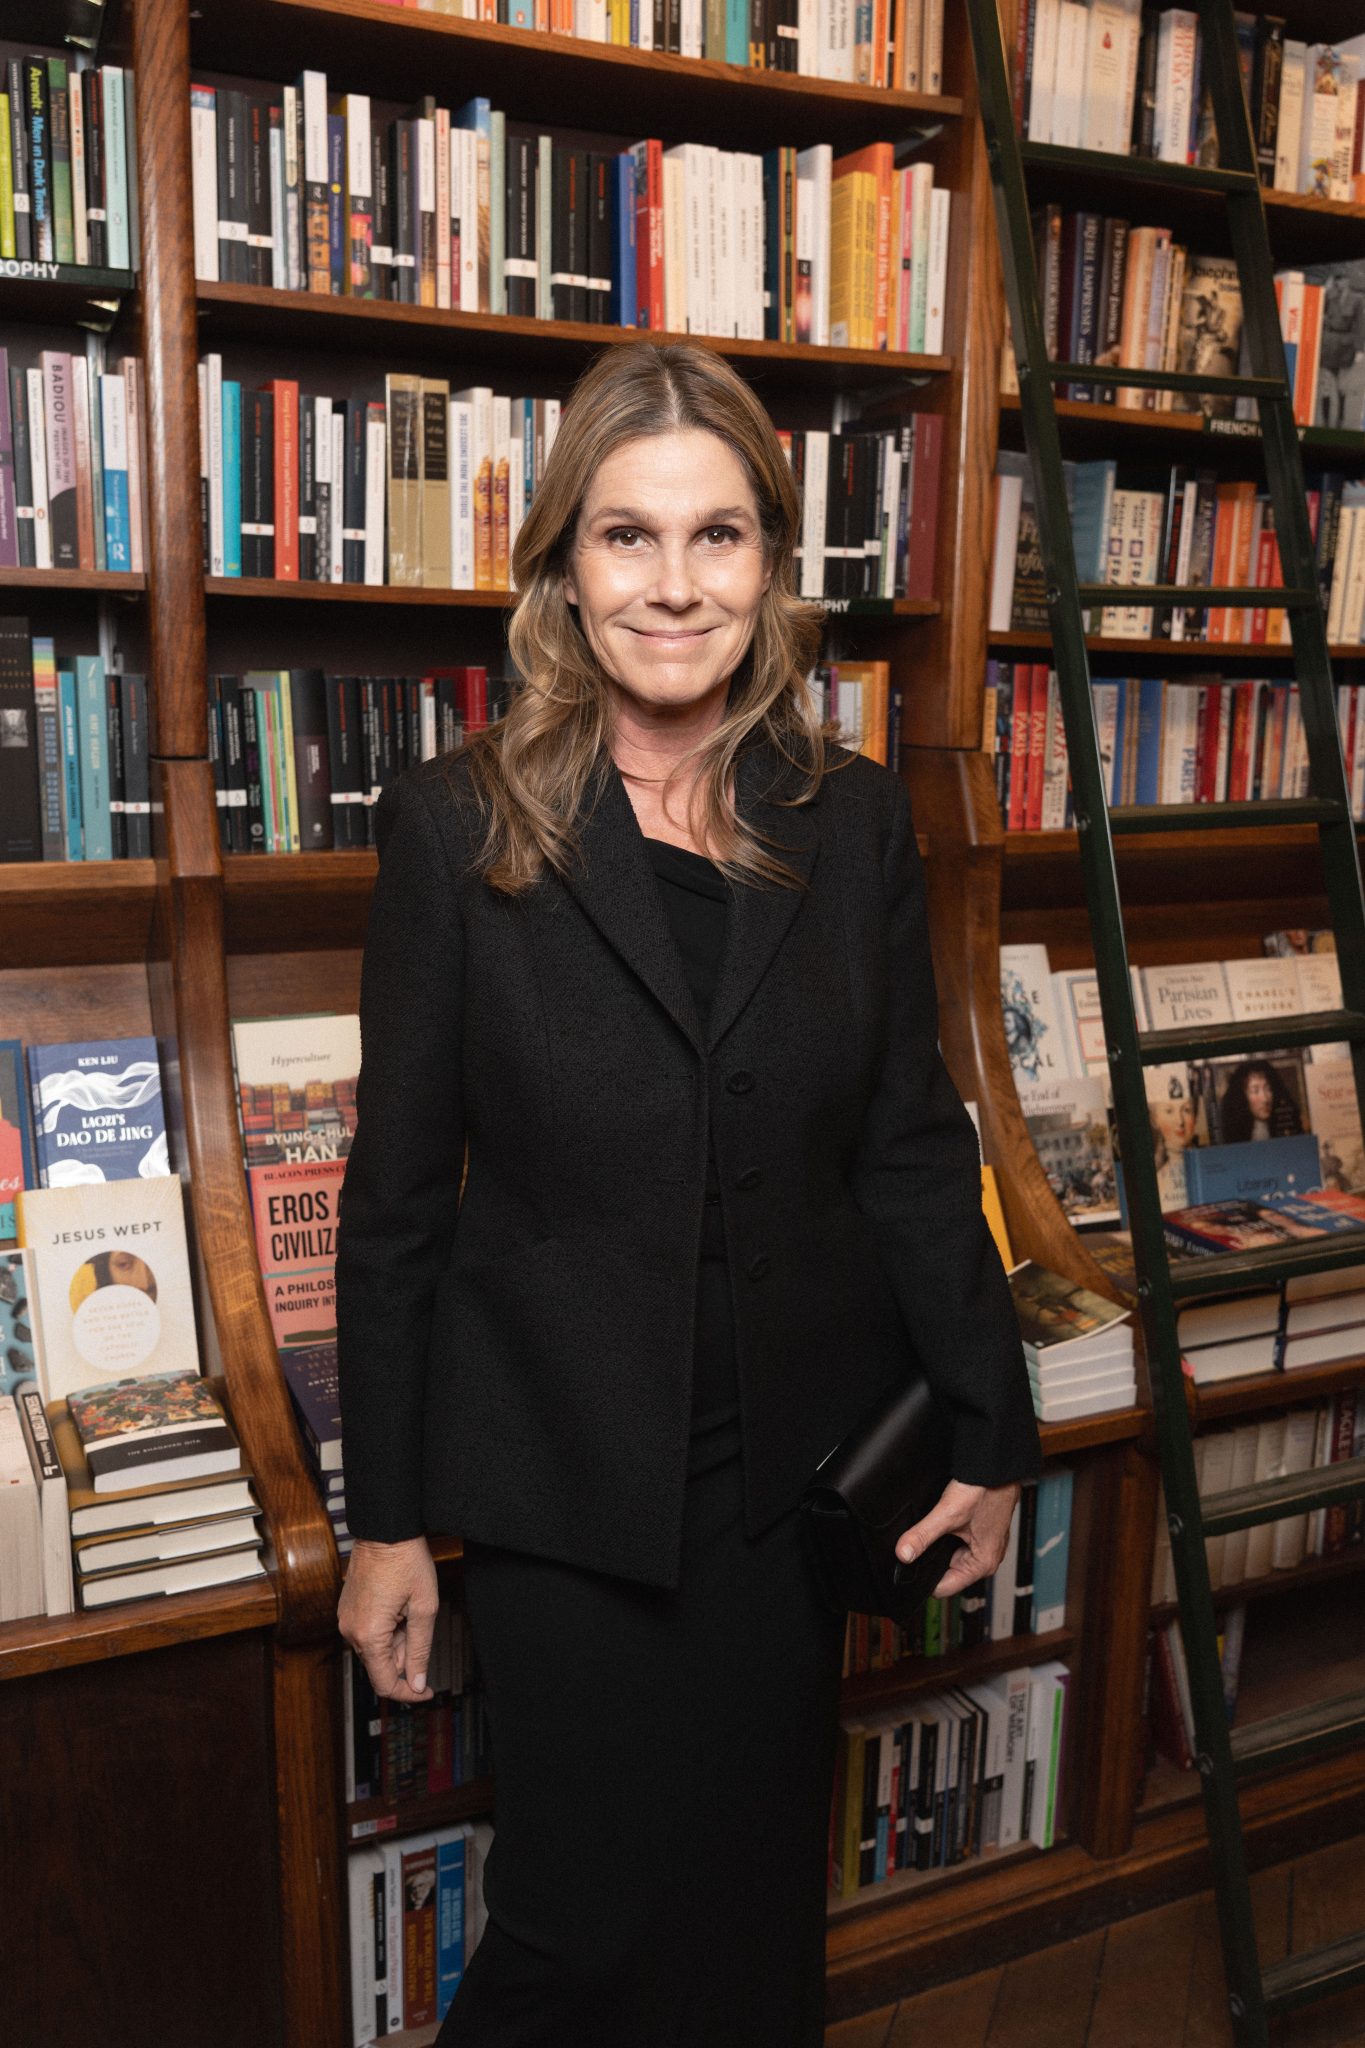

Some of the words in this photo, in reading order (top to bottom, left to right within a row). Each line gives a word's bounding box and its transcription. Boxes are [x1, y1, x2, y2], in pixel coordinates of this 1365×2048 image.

[30, 67, 42, 109] Arendt
[1171, 86, 1186, 148] Citizens
[32, 117, 44, 141] Men
[33, 145, 44, 156] in
[33, 159, 45, 185] Dark
[35, 188, 46, 220] Times
[879, 243, 890, 254] in
[878, 257, 889, 278] His
[877, 281, 890, 317] World
[51, 364, 65, 423] BADIOU
[1015, 711, 1027, 757] PARIS
[1031, 711, 1046, 757] PARIS
[1180, 748, 1196, 793] PARIS
[1157, 986, 1218, 1005] Parisian
[1172, 1004, 1213, 1022] Lives
[78, 1057, 99, 1067] KEN
[100, 1055, 118, 1066] LIU
[271, 1053, 331, 1067] Hyperculture
[81, 1114, 126, 1129] LAOZI'S
[56, 1130, 92, 1147] DAO
[95, 1128, 117, 1144] DE
[119, 1125, 153, 1142] JING
[265, 1126, 354, 1145] BYUNG-CHUL
[286, 1144, 338, 1165] HAN
[268, 1190, 330, 1226] EROS
[52, 1228, 106, 1245] JESUS
[113, 1221, 163, 1238] WEPT
[275, 1286, 284, 1297] A
[288, 1279, 336, 1295] PHILOS
[275, 1297, 320, 1313] INQUIRY
[322, 1295, 336, 1306] INT
[1009, 1695, 1017, 1710] OF
[1006, 1714, 1017, 1762] MEMORY
[1016, 1718, 1024, 1737] ART
